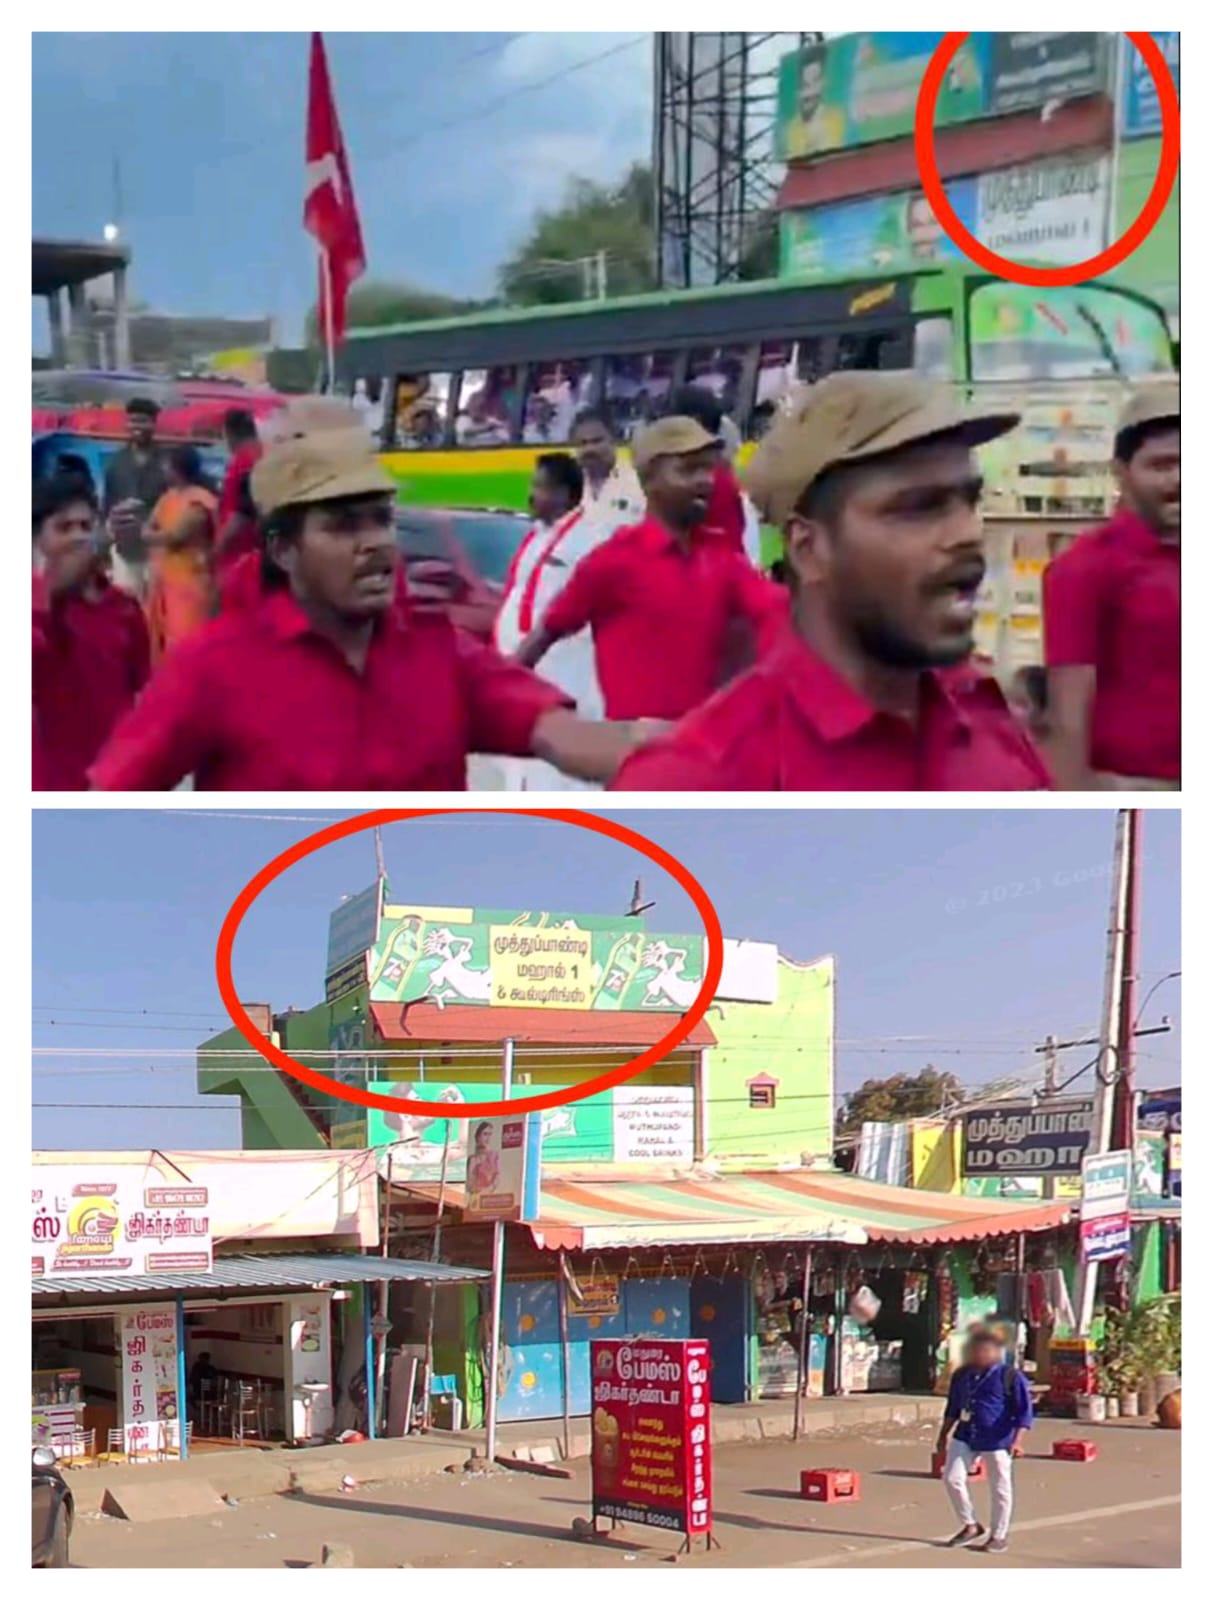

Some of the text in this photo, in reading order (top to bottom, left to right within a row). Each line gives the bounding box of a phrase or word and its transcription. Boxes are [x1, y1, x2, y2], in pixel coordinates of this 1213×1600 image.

[494, 933, 588, 958] முத்துப்பாண்டி
[517, 962, 578, 981] மஹால் 1
[967, 1146, 1083, 1170] மஹா
[616, 1346, 681, 1381] பேமஸ்
[594, 1380, 680, 1406] ஜிகர்தண்டா
